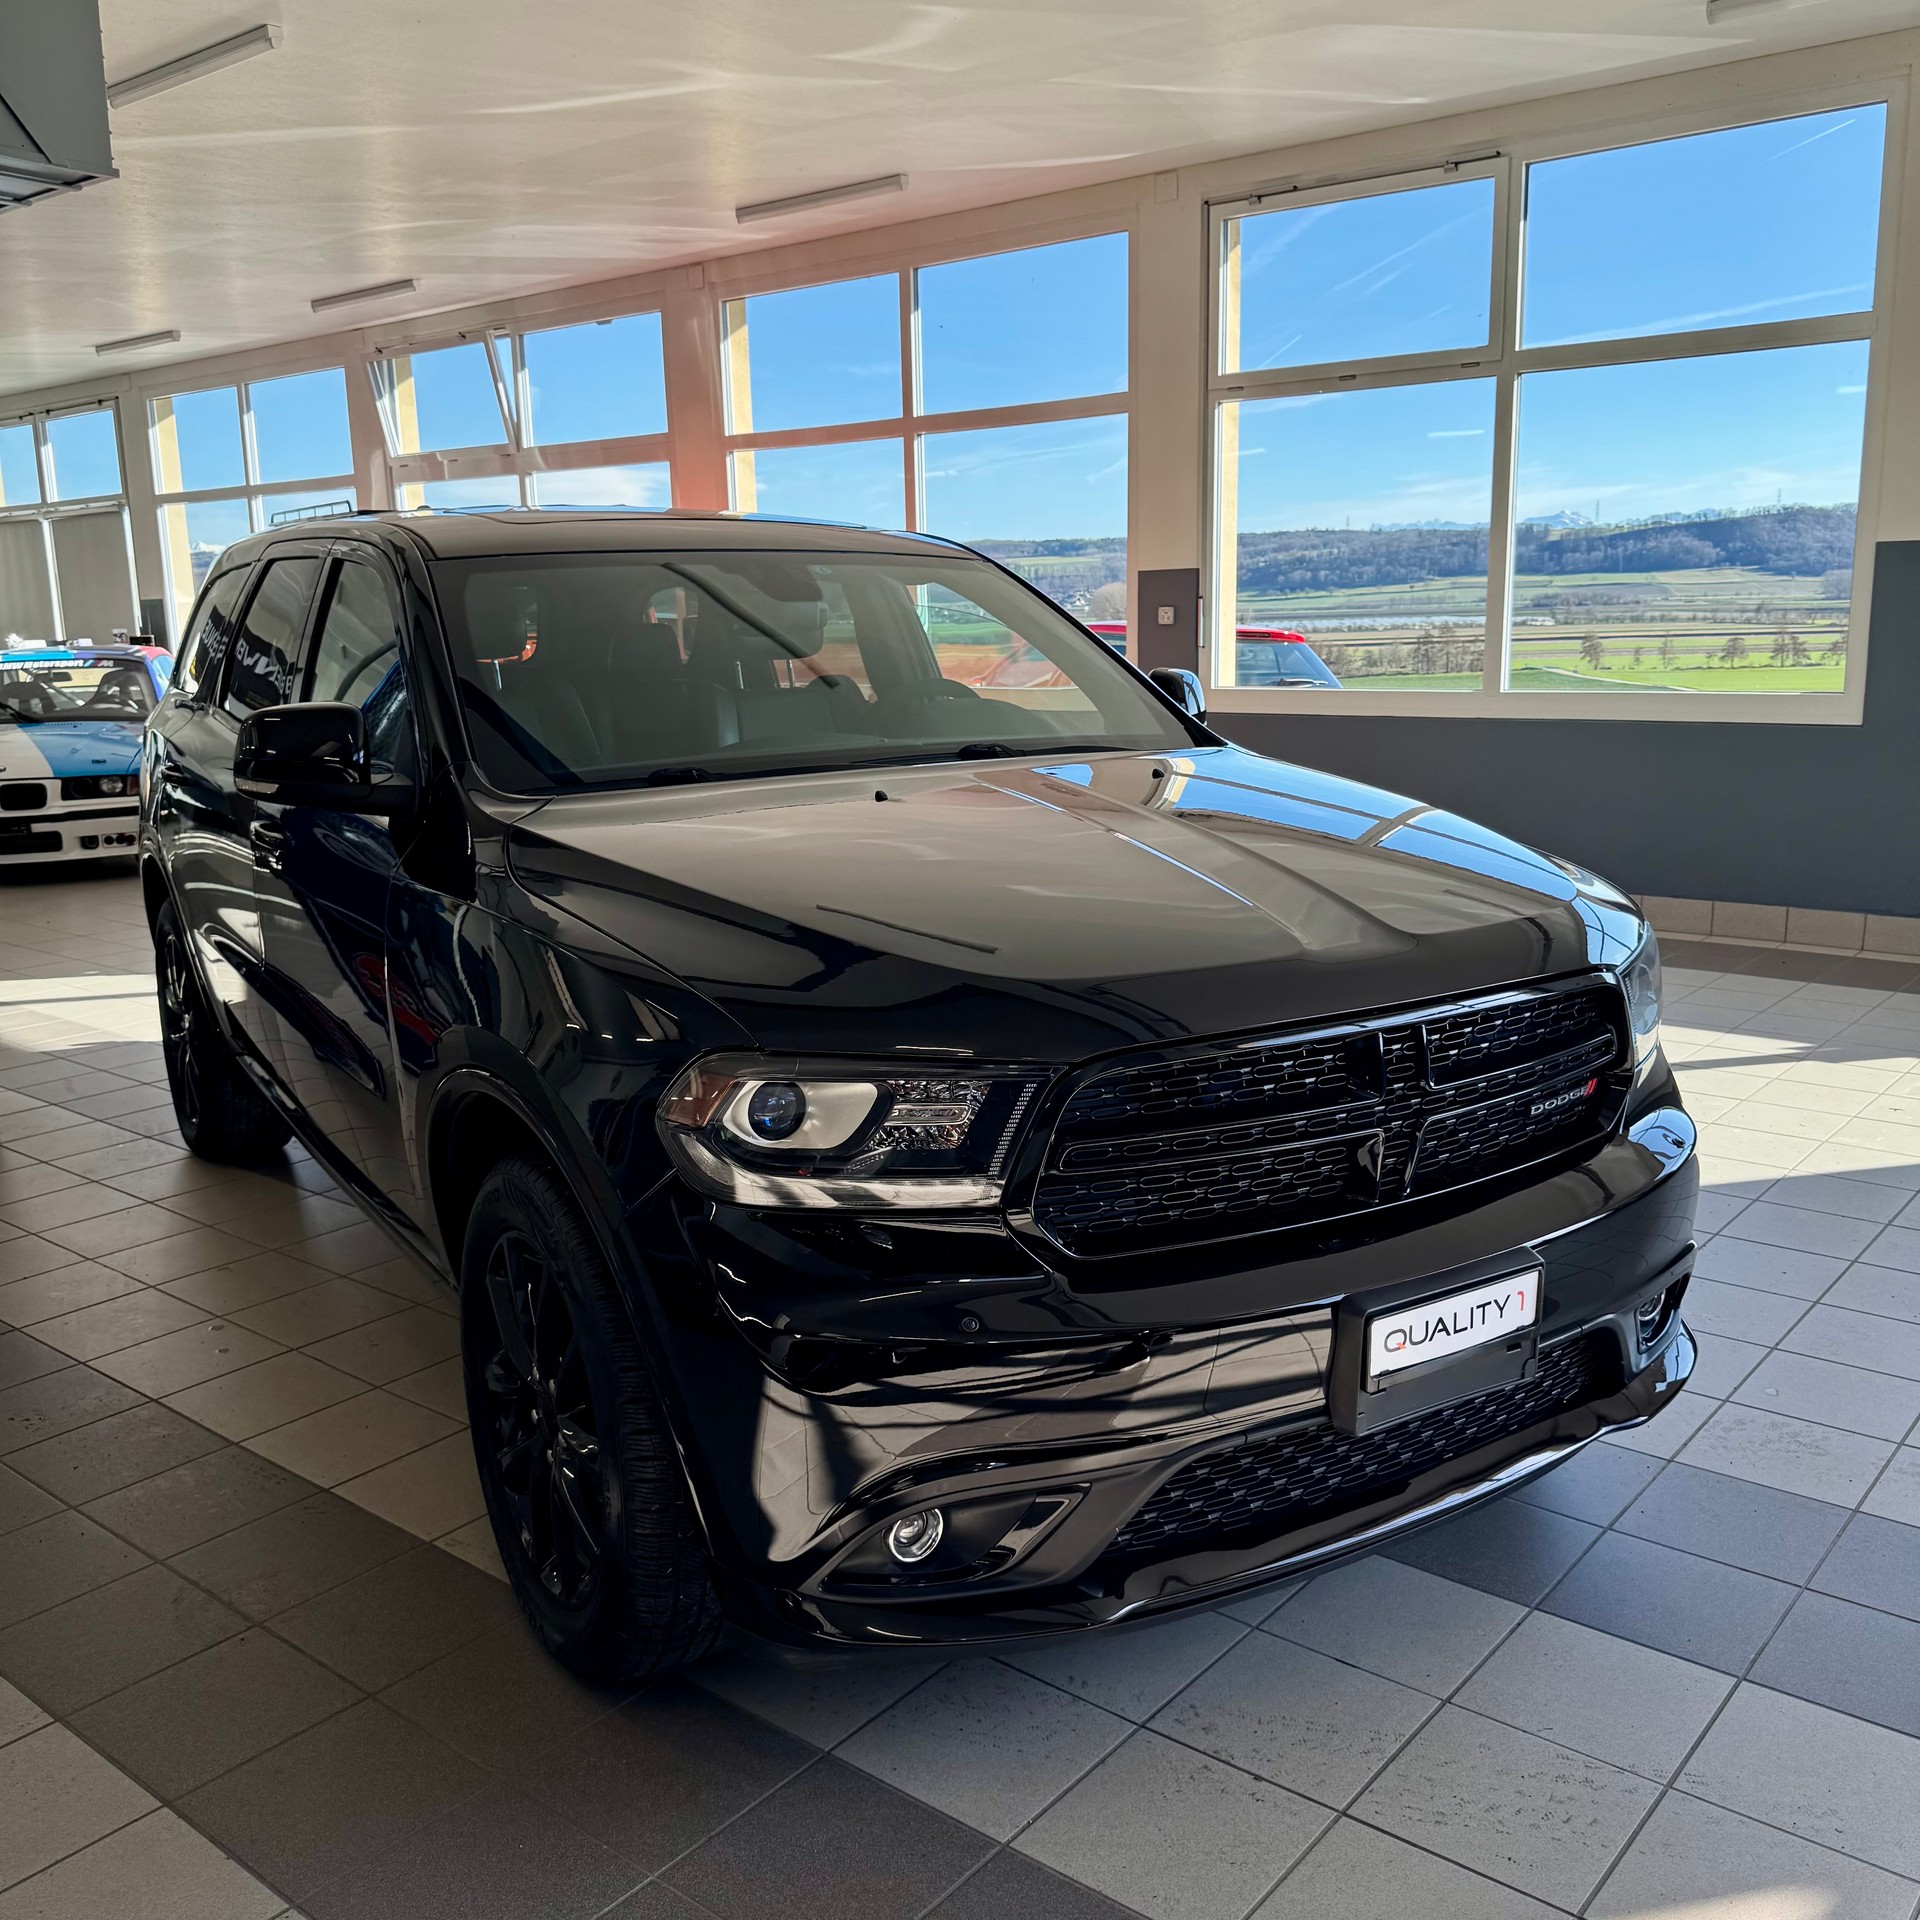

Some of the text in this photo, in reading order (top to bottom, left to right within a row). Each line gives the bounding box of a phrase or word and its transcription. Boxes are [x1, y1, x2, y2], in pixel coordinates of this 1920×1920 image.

[22, 660, 84, 669] Motorsport
[1530, 1085, 1588, 1115] DODGE
[1383, 1290, 1525, 1353] QUALITY 1
